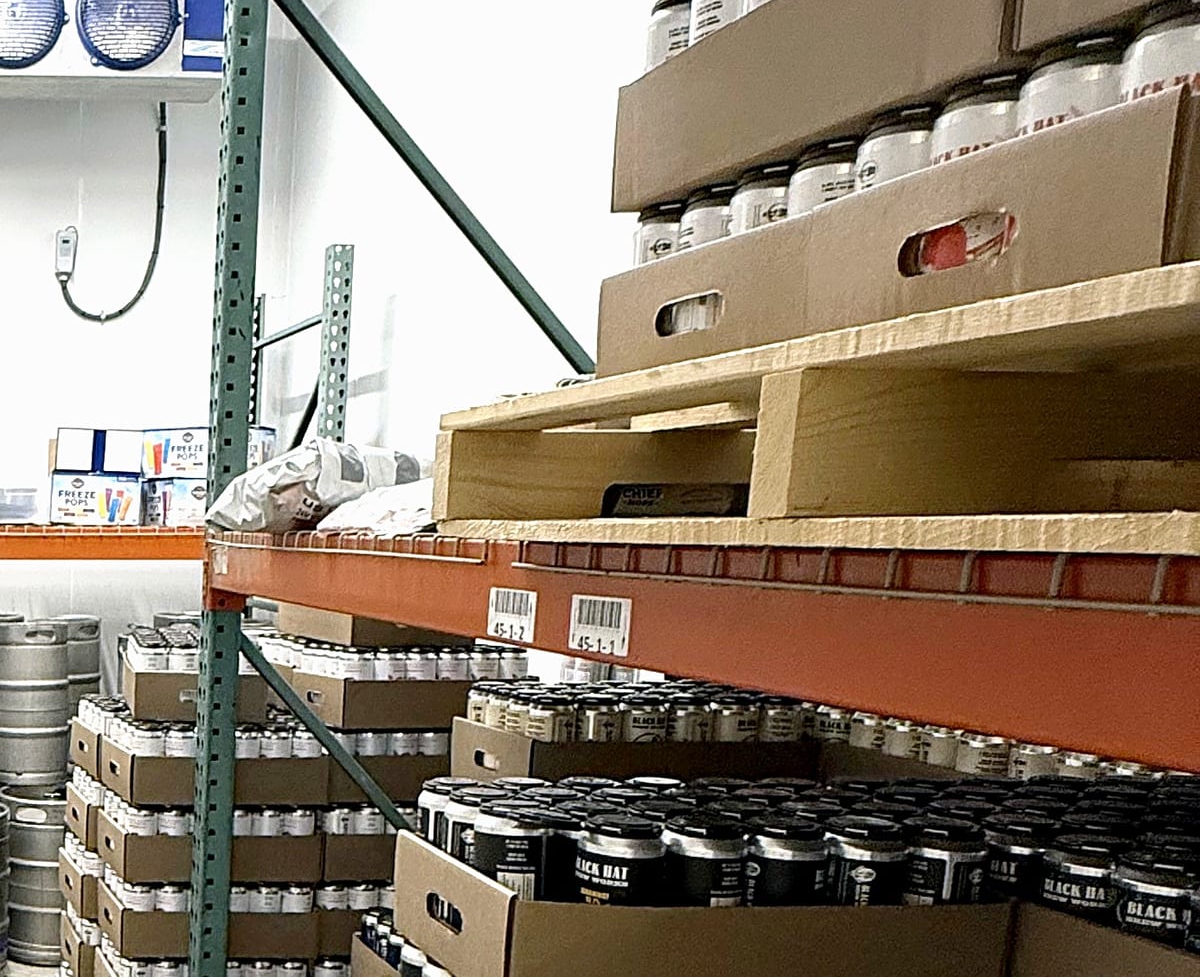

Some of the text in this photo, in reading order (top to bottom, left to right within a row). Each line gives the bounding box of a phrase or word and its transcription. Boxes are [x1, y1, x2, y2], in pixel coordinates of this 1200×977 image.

[171, 444, 204, 453] FREEZE
[176, 452, 198, 460] POPS
[58, 489, 96, 499] FREEZE
[65, 498, 89, 507] POPS
[493, 621, 525, 640] 45-1-2
[577, 635, 616, 655] 45-1-1
[603, 863, 629, 881] HAT
[1044, 878, 1081, 898] BLACK
[1127, 901, 1177, 922] BLACK
